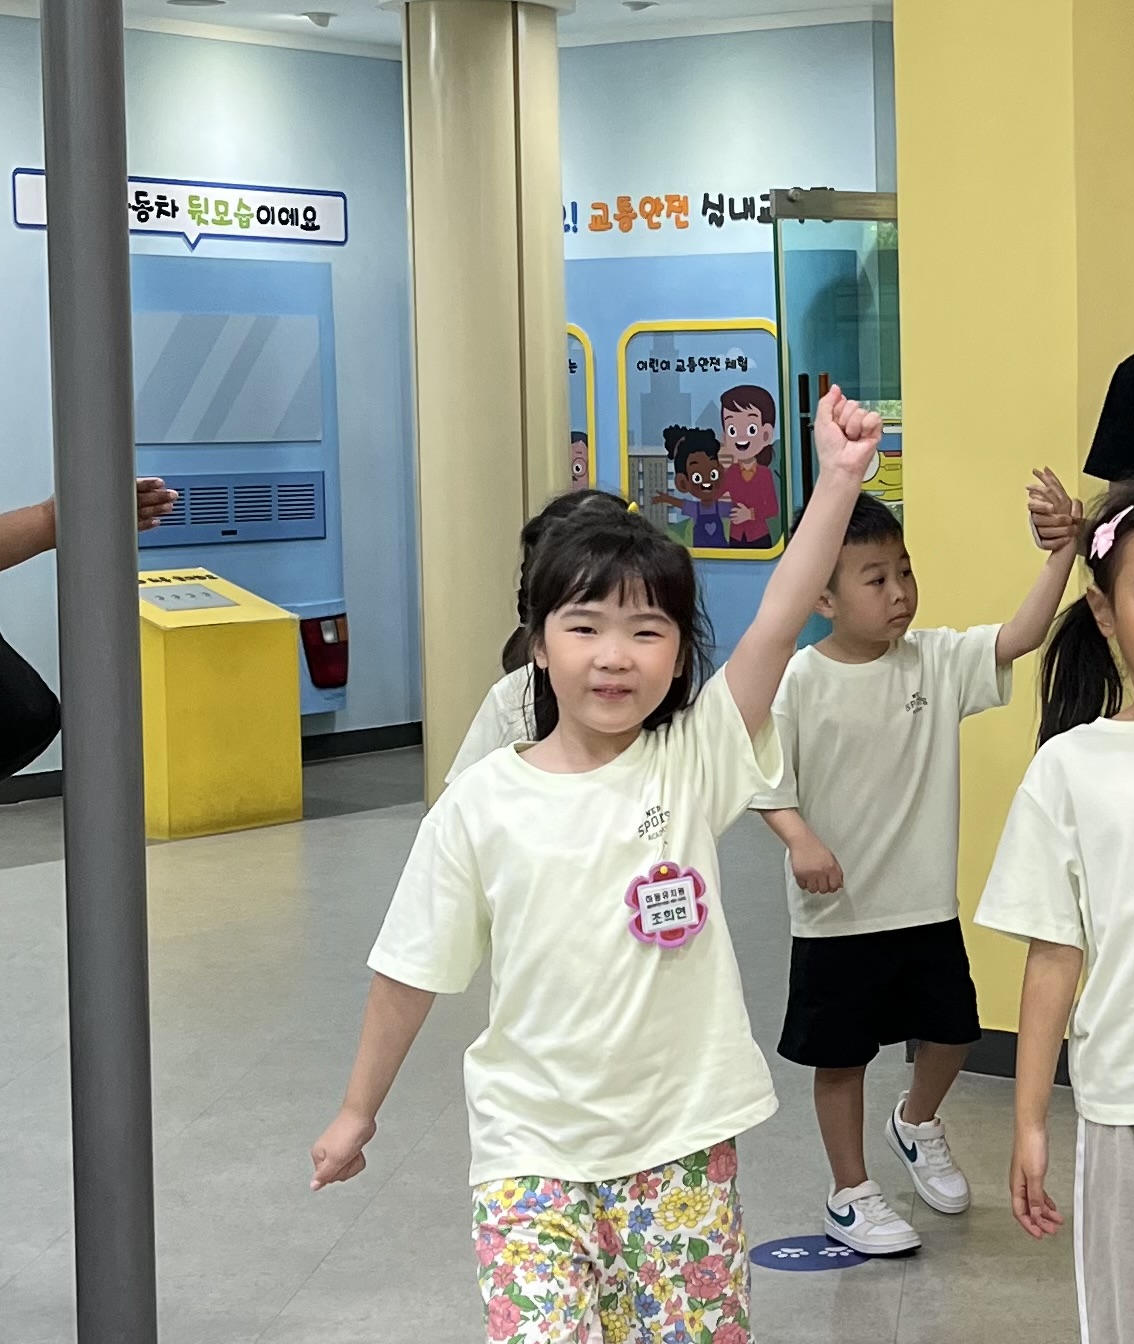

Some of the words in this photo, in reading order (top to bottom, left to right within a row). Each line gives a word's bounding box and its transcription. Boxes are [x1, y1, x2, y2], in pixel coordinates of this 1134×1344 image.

[128, 190, 179, 223] 동차
[187, 194, 321, 231] 뒷모습이에요
[588, 194, 689, 233] 교통안전
[636, 358, 671, 373] 어린이
[675, 356, 721, 373] 교통안전
[725, 356, 748, 372] 체험
